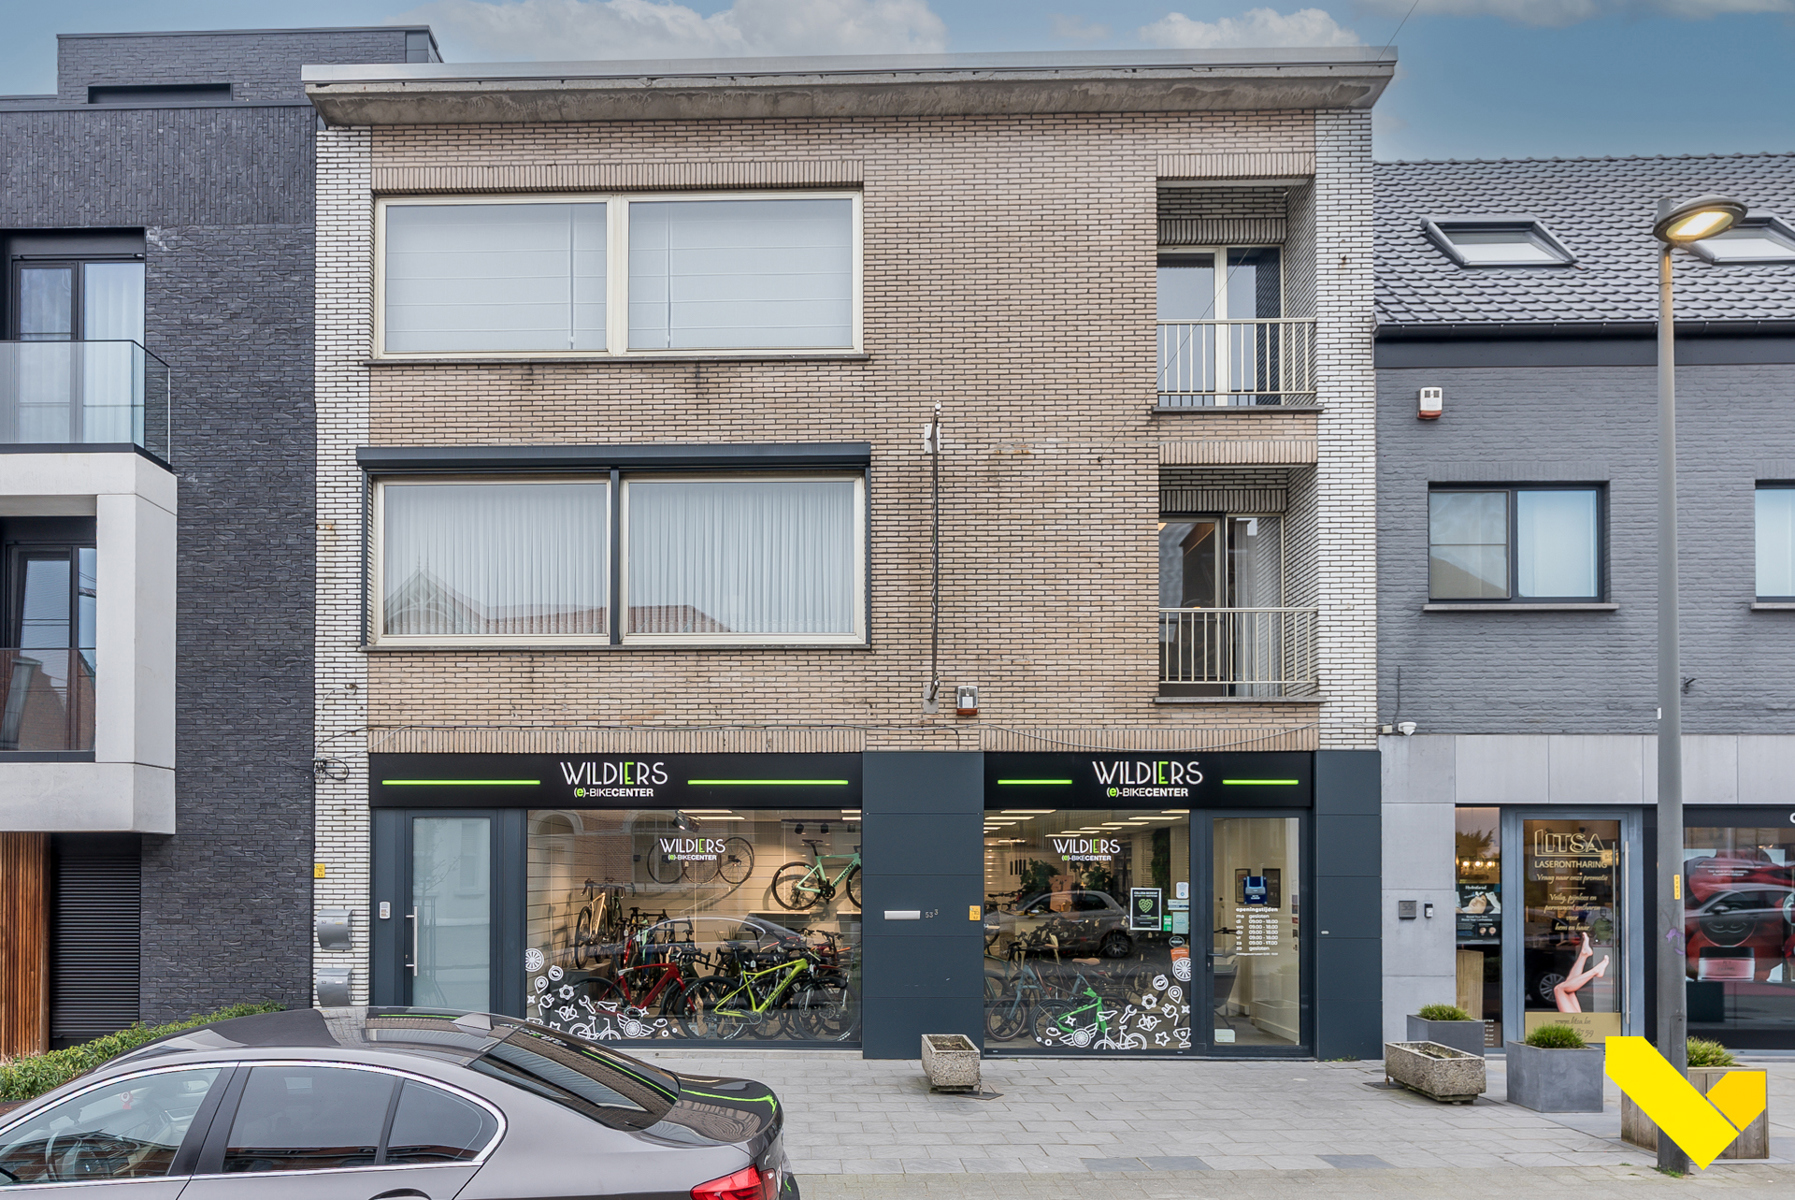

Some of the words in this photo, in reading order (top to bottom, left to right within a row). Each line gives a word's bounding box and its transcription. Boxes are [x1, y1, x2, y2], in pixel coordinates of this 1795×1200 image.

[560, 761, 668, 785] WILDIERS
[1092, 761, 1203, 785] WILDIERS
[573, 787, 654, 798] (e)-BIKECENTER
[1106, 786, 1189, 798] (e)-BIKECENTER
[659, 838, 726, 853] WILDIERS
[1053, 838, 1121, 854] WILDIERS
